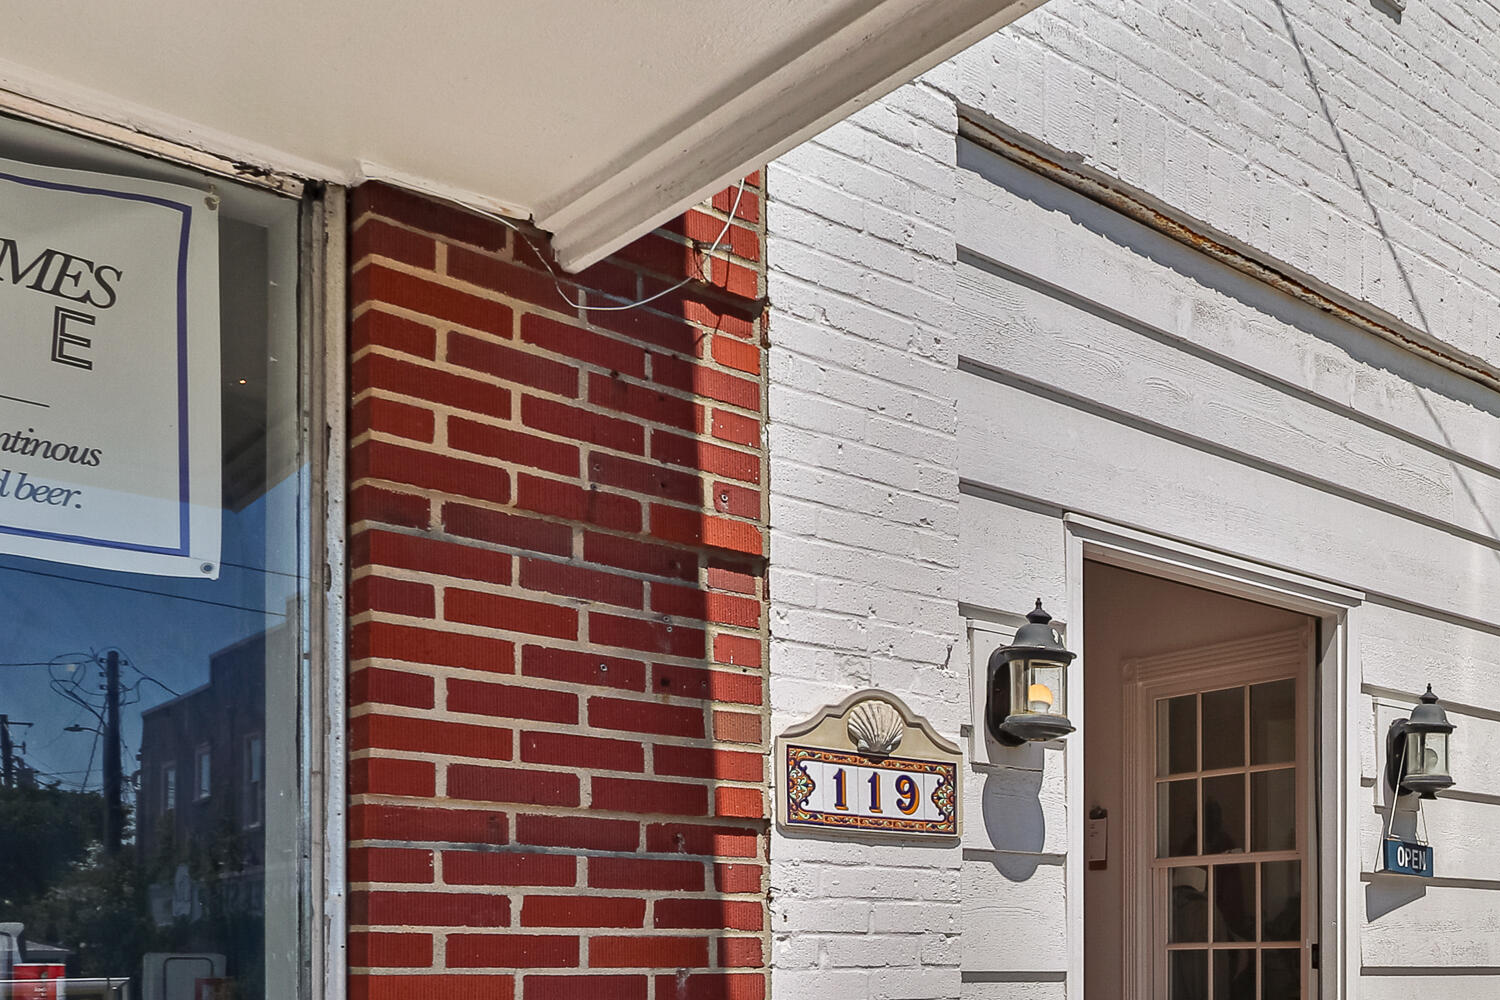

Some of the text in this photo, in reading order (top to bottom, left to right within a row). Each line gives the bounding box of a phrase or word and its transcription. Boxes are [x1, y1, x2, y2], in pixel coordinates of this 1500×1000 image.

[0, 237, 123, 309] MES
[51, 305, 96, 371] E
[14, 472, 82, 509] beer.
[832, 767, 920, 815] 119
[1397, 845, 1427, 871] OPEN
